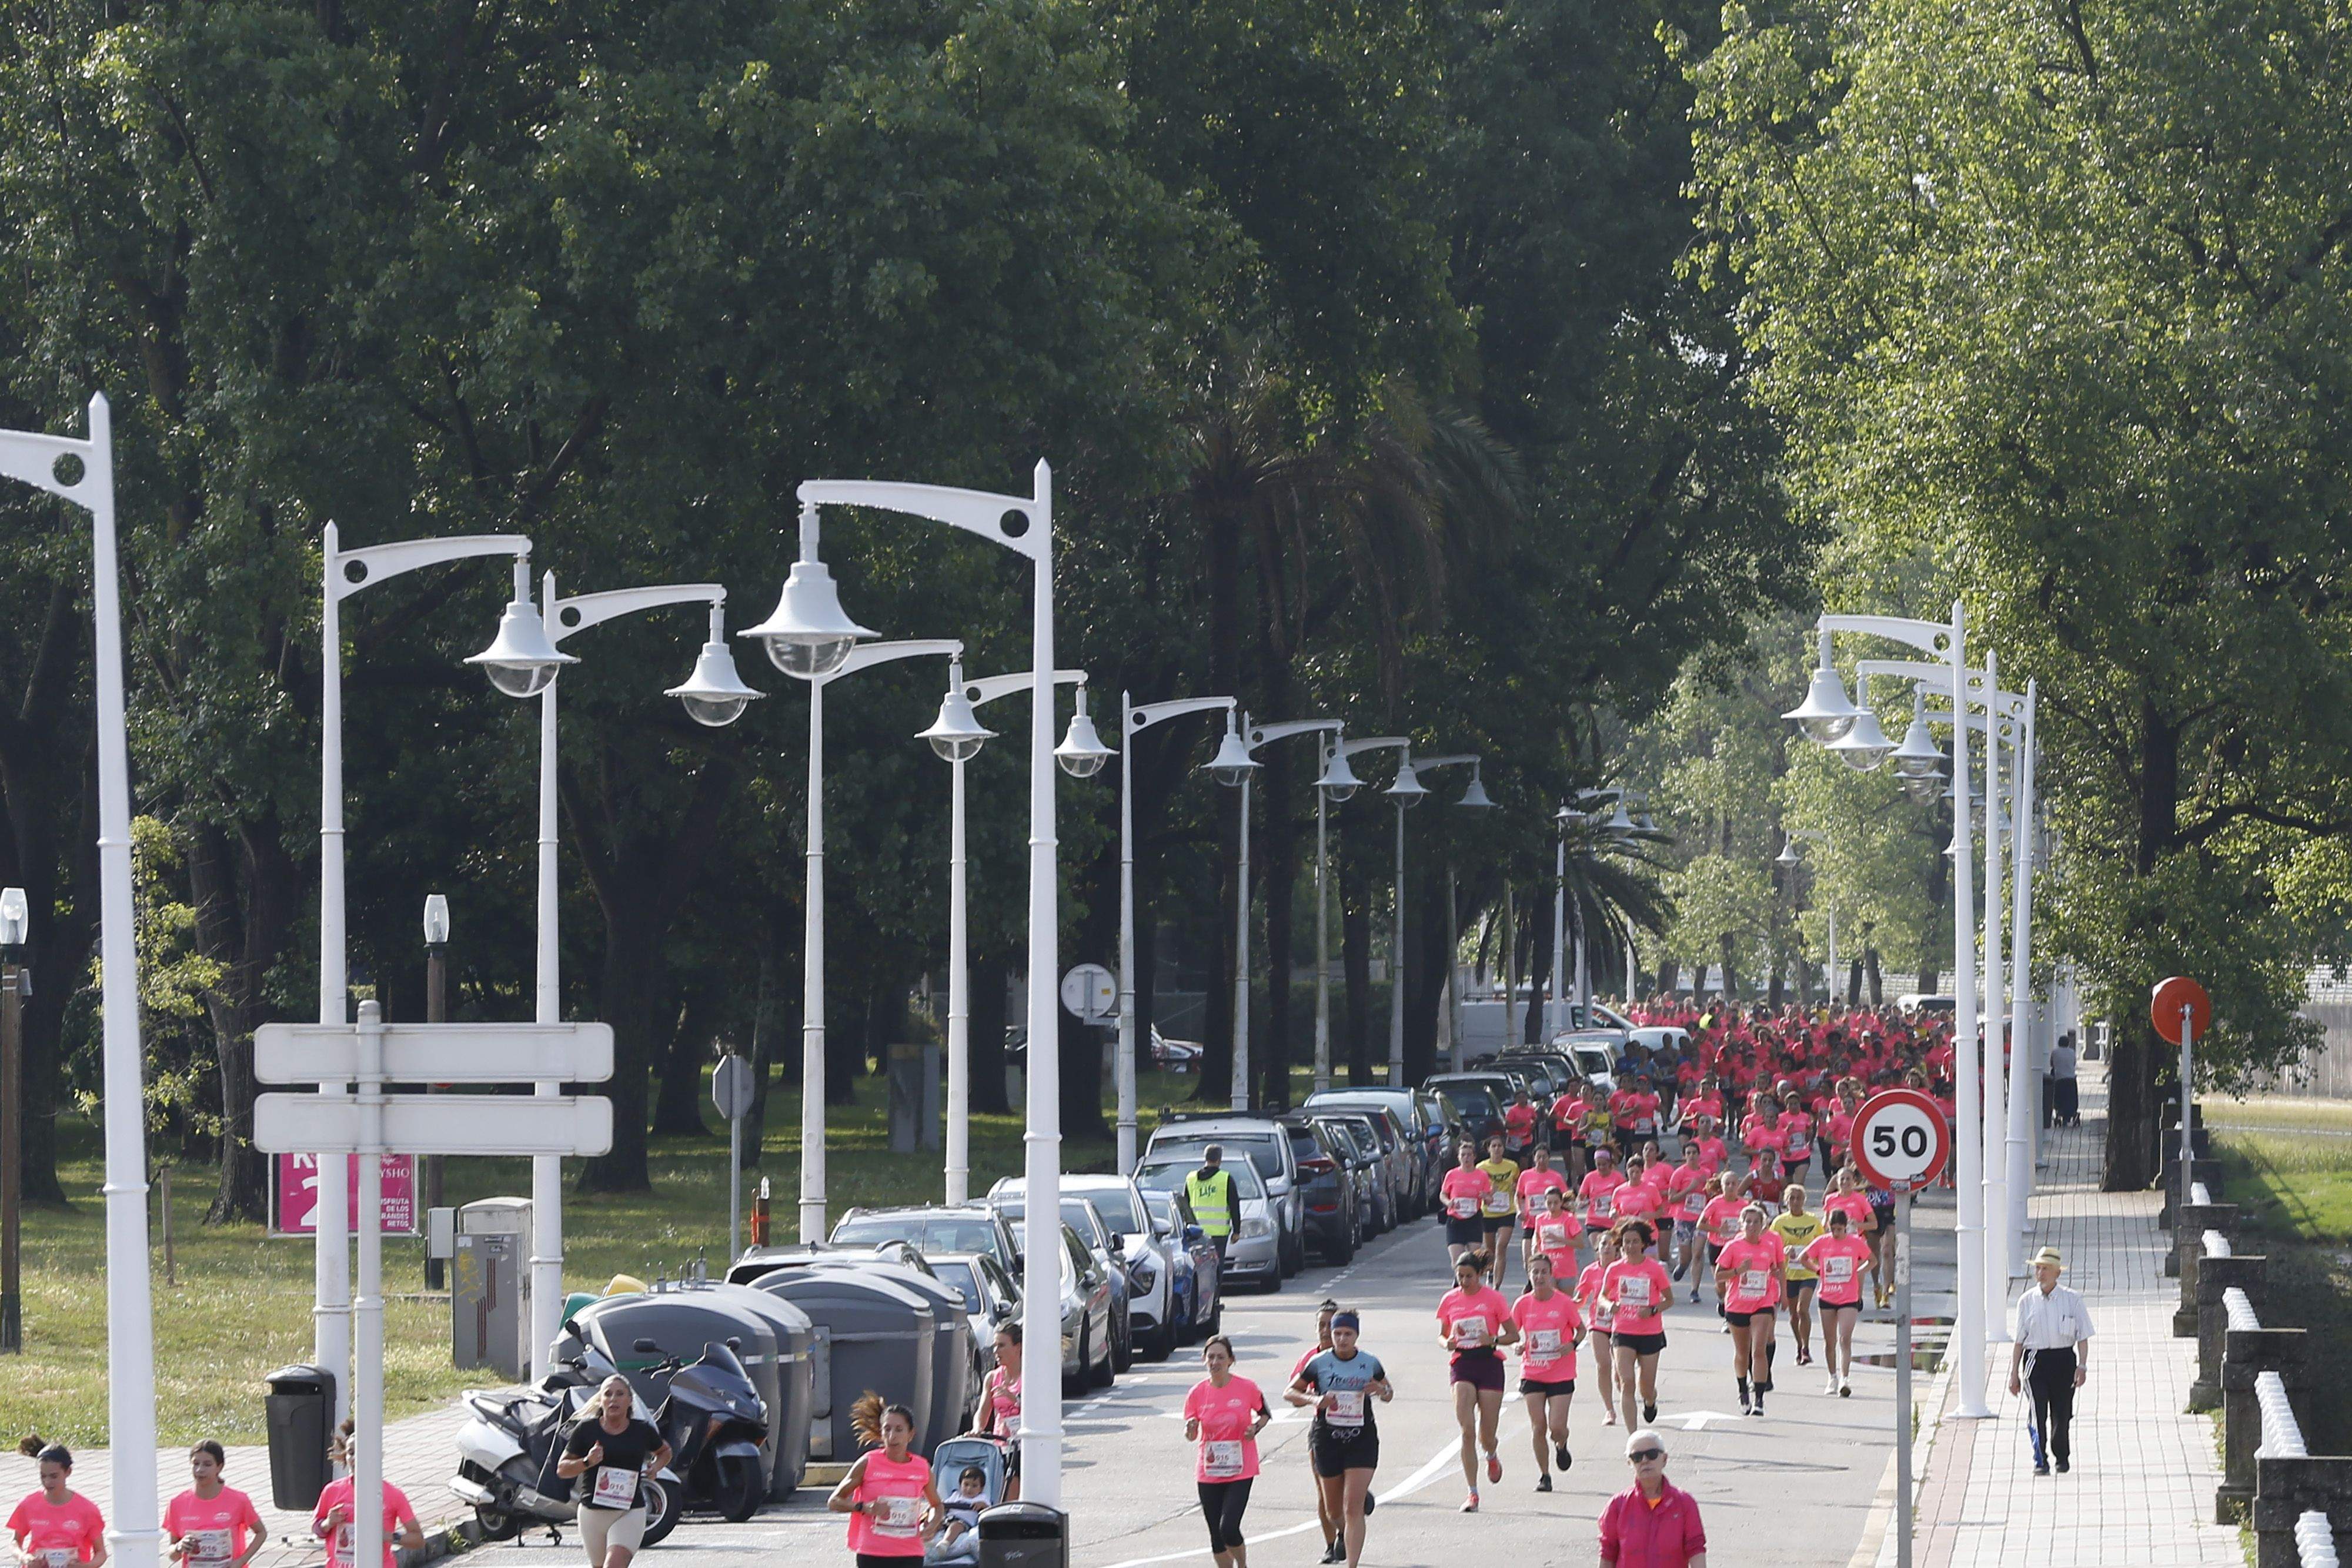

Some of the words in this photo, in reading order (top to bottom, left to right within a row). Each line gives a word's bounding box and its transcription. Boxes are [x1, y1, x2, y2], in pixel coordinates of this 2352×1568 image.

[1873, 1125, 1927, 1158] 50
[381, 1168, 409, 1178] YSHO
[1200, 1185, 1217, 1197] Life
[610, 1483, 624, 1492] 016
